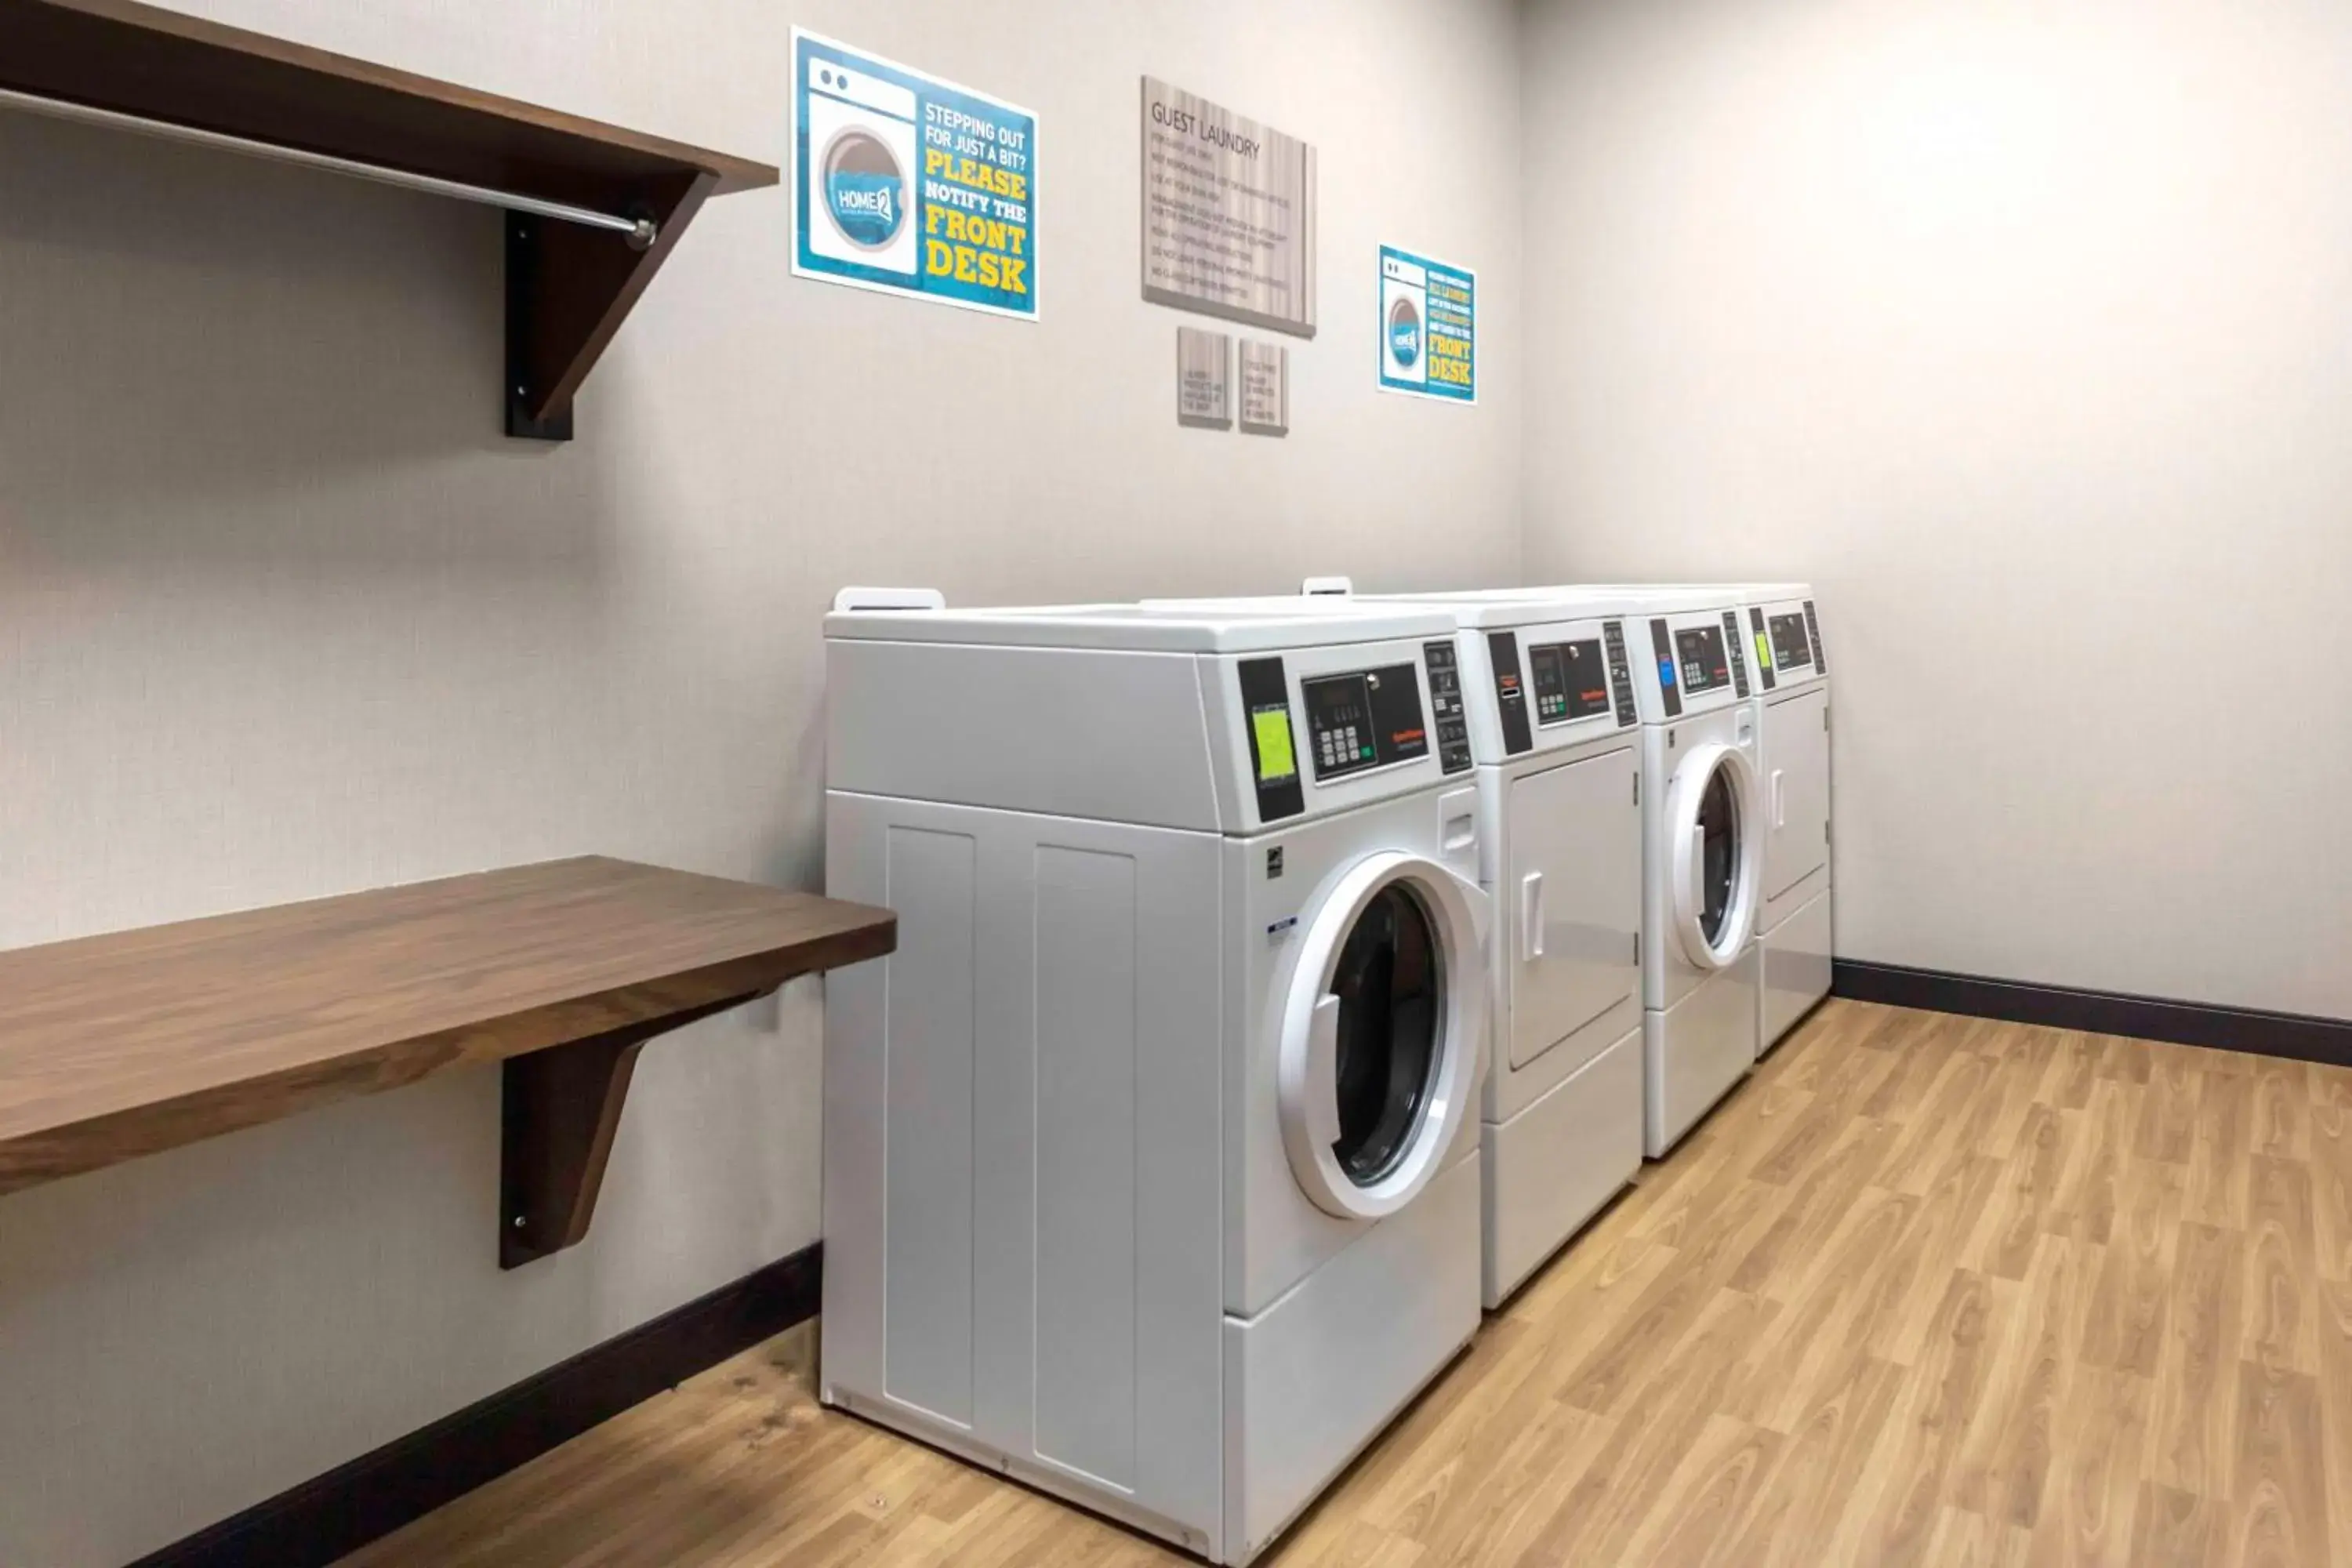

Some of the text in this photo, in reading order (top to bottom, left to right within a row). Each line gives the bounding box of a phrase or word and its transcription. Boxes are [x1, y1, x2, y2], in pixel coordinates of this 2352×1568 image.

[927, 103, 1025, 151] STEPPING OUT
[927, 125, 1025, 170] FOR JUST A BIT?
[1152, 103, 1195, 136] GUEST
[1201, 122, 1259, 160] LAUNDRY
[926, 147, 1025, 201] PLEASE
[926, 180, 1025, 223] NOTIFY THE
[927, 204, 1025, 254] FRONT
[927, 239, 1026, 293] DESK
[1430, 335, 1470, 360] FRONT
[1430, 356, 1471, 384] DESK
